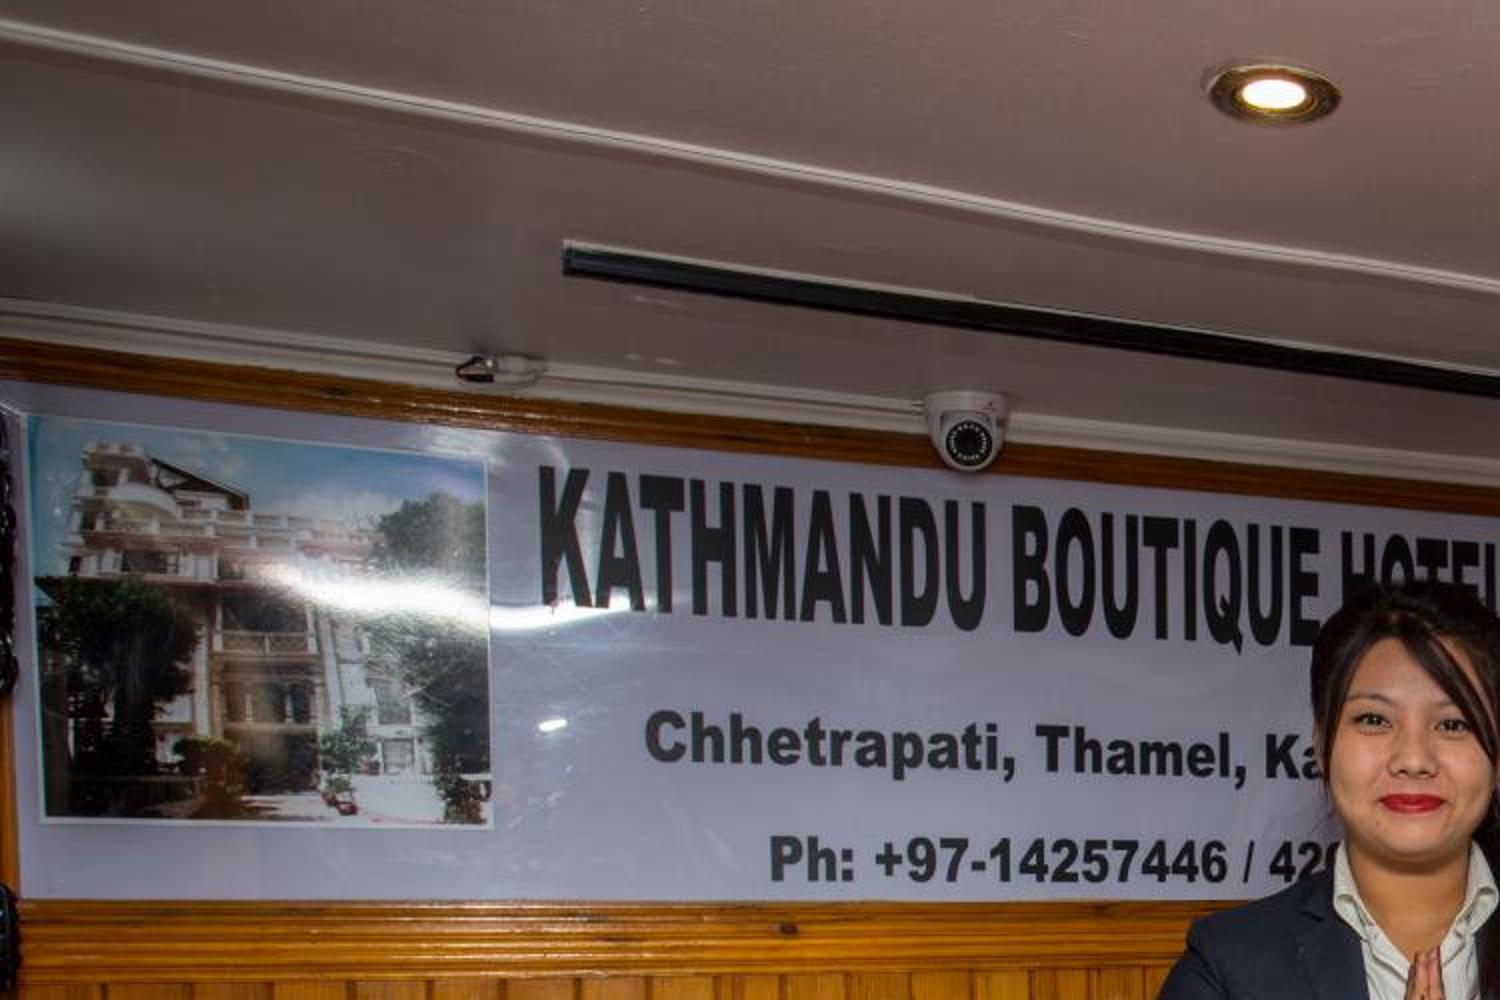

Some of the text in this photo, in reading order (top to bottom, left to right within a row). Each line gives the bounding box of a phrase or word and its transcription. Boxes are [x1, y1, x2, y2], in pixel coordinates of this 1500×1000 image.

[538, 465, 986, 632] KATHMANDU
[1012, 504, 1321, 656] BOUTIQUE
[644, 710, 1016, 783] Chhetrapati,
[1036, 723, 1247, 790] Thamel,
[769, 835, 854, 883] Ph:
[875, 836, 1229, 884] +97-14257446
